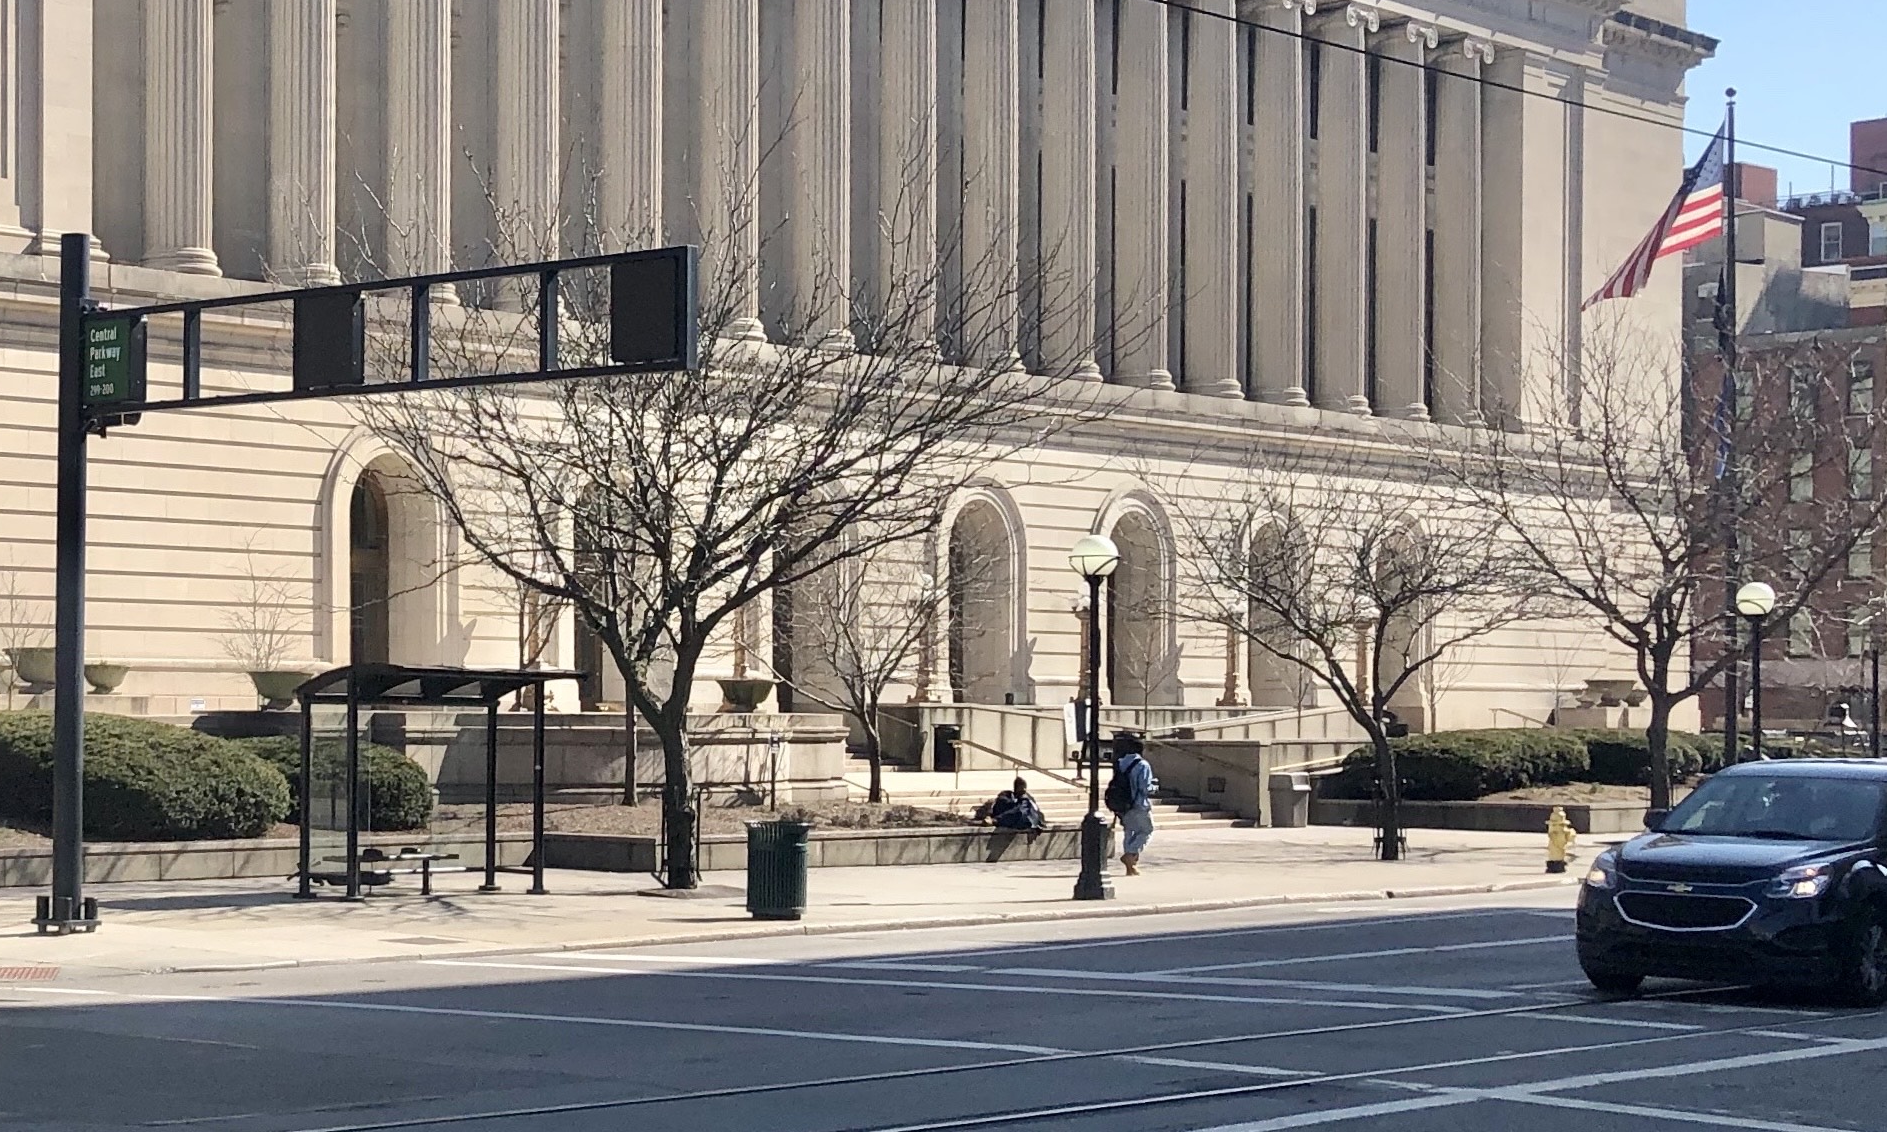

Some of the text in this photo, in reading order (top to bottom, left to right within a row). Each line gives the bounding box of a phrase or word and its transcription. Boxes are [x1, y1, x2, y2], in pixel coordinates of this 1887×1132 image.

[90, 327, 117, 343] Central
[90, 346, 121, 362] Parkway
[90, 364, 106, 379] East
